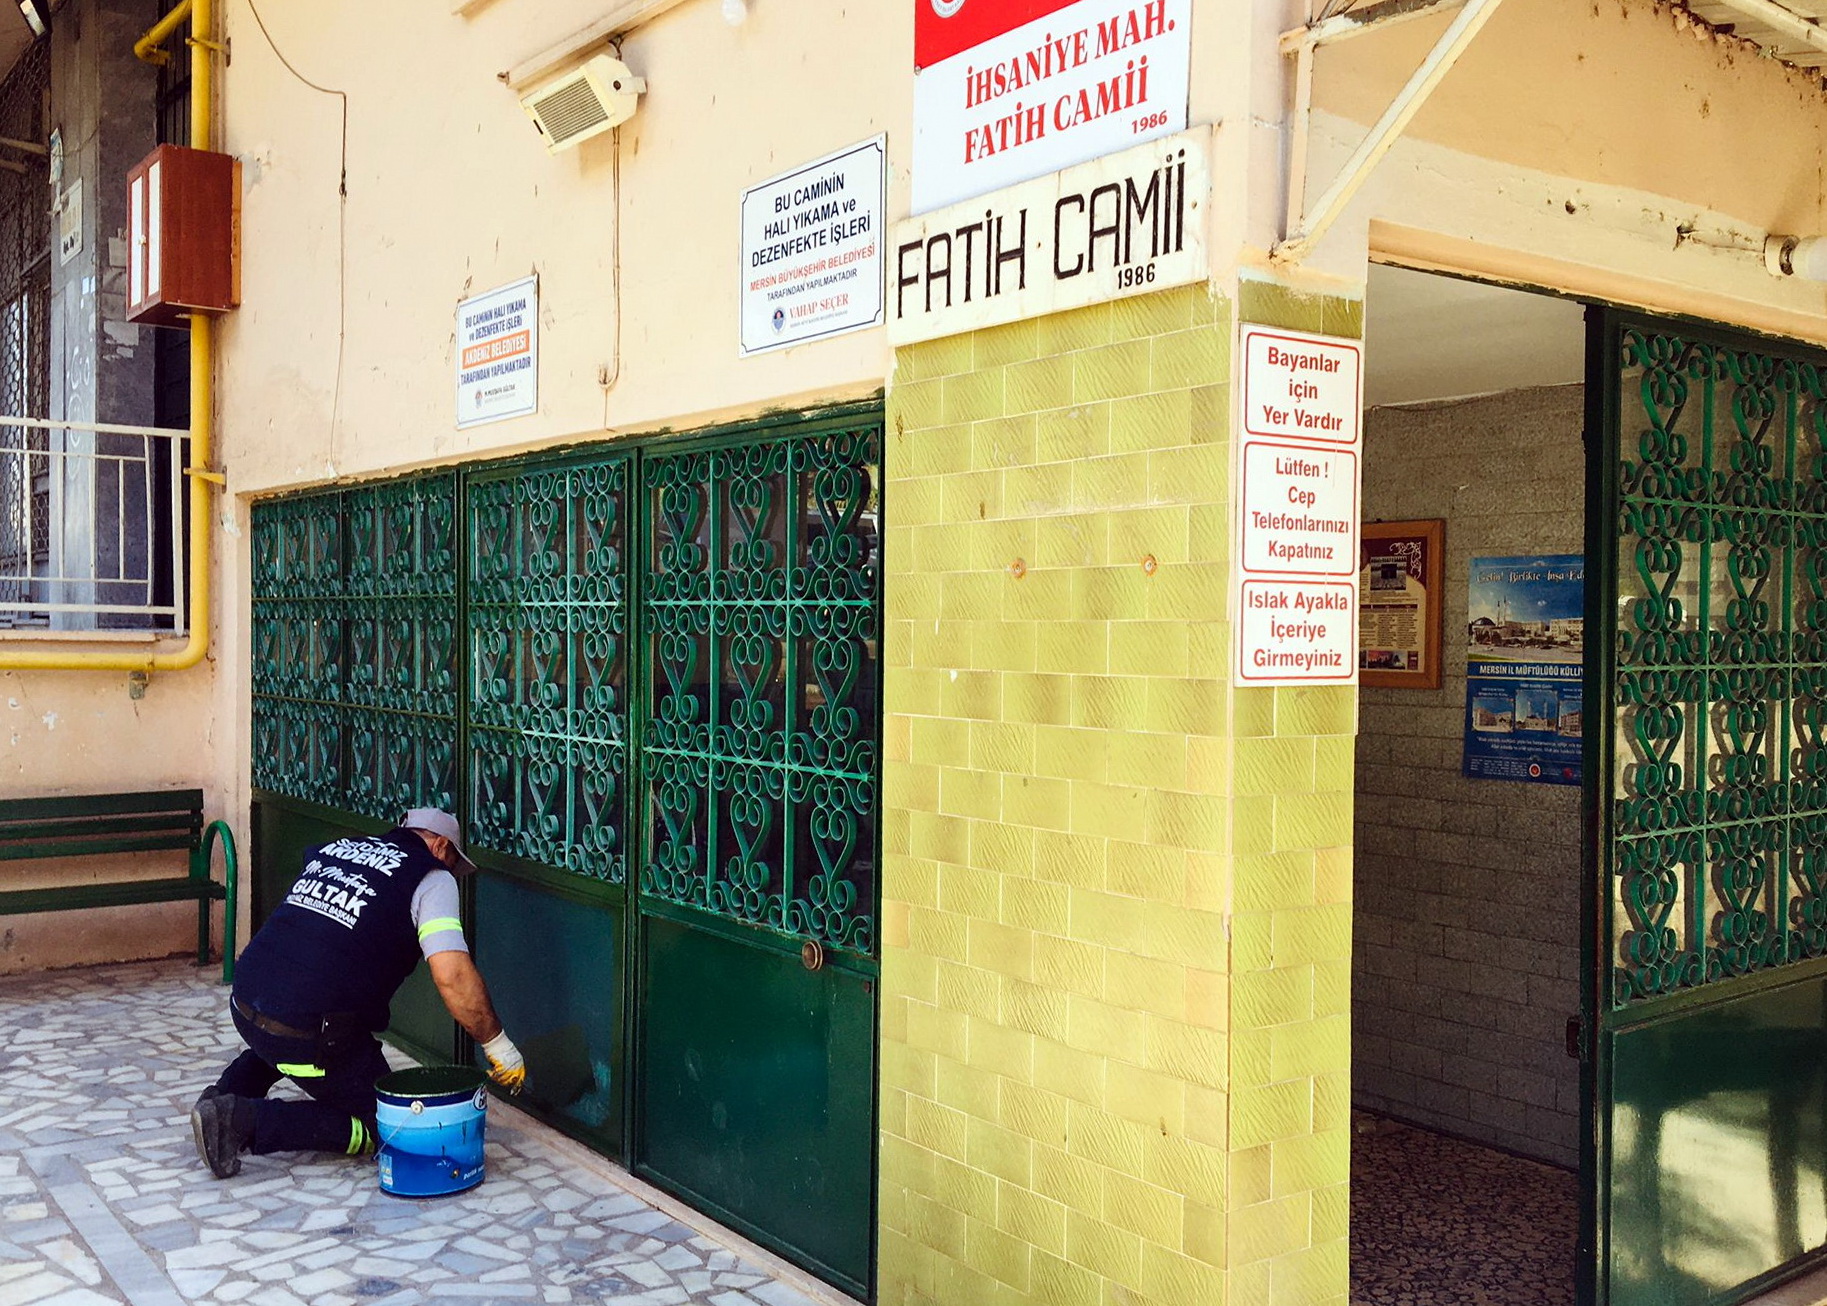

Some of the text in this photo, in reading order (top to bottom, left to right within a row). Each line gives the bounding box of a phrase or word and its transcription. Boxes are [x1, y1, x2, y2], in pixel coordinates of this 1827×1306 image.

[965, 0, 1175, 109] İHSANİYE MAH.
[964, 55, 1149, 164] FATİH CAMİİ
[1131, 110, 1168, 134] 1986
[775, 172, 844, 214] BU CAMİNİN
[764, 198, 856, 240] HALI YIKAMA ve
[752, 210, 871, 268] DEZENFEKTE İŞLERİ
[897, 148, 1186, 319] FATİH CAMİİ
[750, 242, 875, 292] MERSİN BÜYÜKŞEHİR BELEDİYESİ
[1118, 263, 1155, 289] 1986
[767, 268, 857, 301] TARAFINDAN YAPILMAKTADIR
[494, 304, 505, 319] HALI
[506, 298, 526, 315] YIKAMA
[790, 301, 818, 319] VAHAP
[820, 293, 849, 311] SEÇER
[475, 320, 505, 340] DEZENFEKTE
[461, 356, 531, 385] TARAFINDAN YAPILMAKTADIR
[1268, 346, 1340, 373] Bayanlar
[1289, 379, 1318, 403] için
[1262, 405, 1342, 431] Yer Vardır
[1276, 457, 1320, 477] Lütfen
[1288, 486, 1316, 508] Cep
[1252, 511, 1349, 534] Telefonlarınızı
[1268, 540, 1333, 563] Kapatınız
[1249, 590, 1288, 609] Islak
[1294, 591, 1348, 616] Ayakla
[1271, 616, 1326, 643] İçeriye
[1254, 649, 1342, 670] Girmeyiniz
[1480, 664, 1507, 674] MERSİN
[1508, 665, 1514, 674] İL
[1516, 664, 1559, 676] MÜFTÜLÜĞÜ
[319, 843, 401, 877] AKDENİZ
